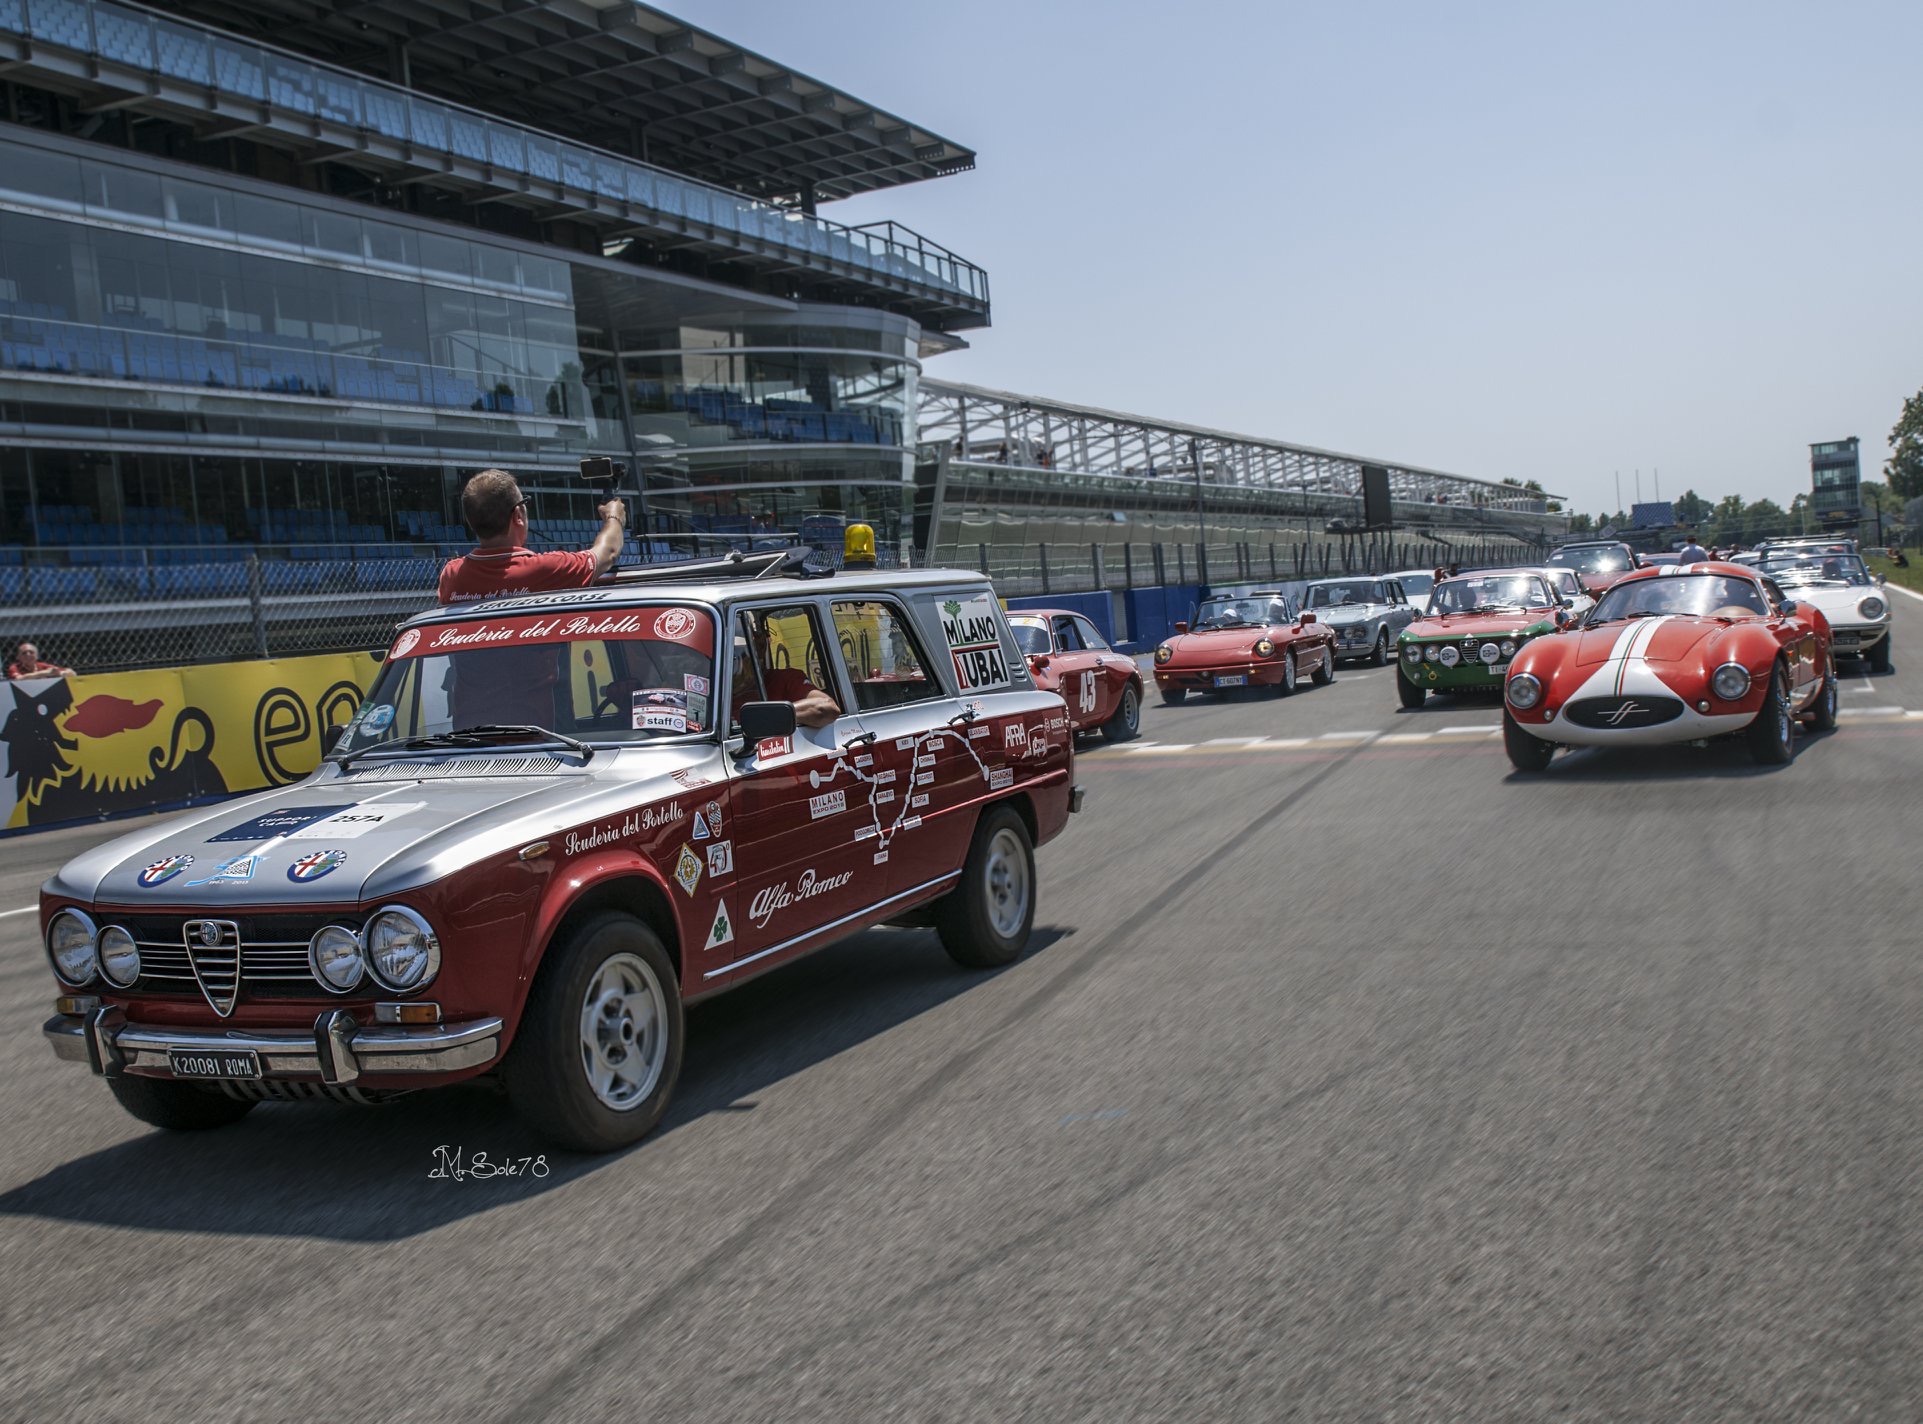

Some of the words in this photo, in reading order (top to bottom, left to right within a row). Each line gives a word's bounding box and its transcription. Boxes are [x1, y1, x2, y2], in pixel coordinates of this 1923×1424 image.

[473, 597, 550, 612] SERVIZIO
[550, 592, 612, 605] CORSE
[430, 625, 514, 648] Scuderia
[519, 618, 561, 639] del
[559, 614, 641, 636] Portello
[1079, 669, 1097, 714] 43
[647, 716, 673, 726] staff
[1005, 722, 1027, 748] AFRA
[811, 792, 844, 809] MILANO
[813, 807, 829, 815] EXPO
[565, 825, 620, 856] Scuderia
[622, 814, 640, 837] del
[642, 801, 684, 831] Portello
[749, 881, 794, 929] Alfa
[794, 868, 854, 902] Romeo
[225, 1058, 254, 1076] ROMA
